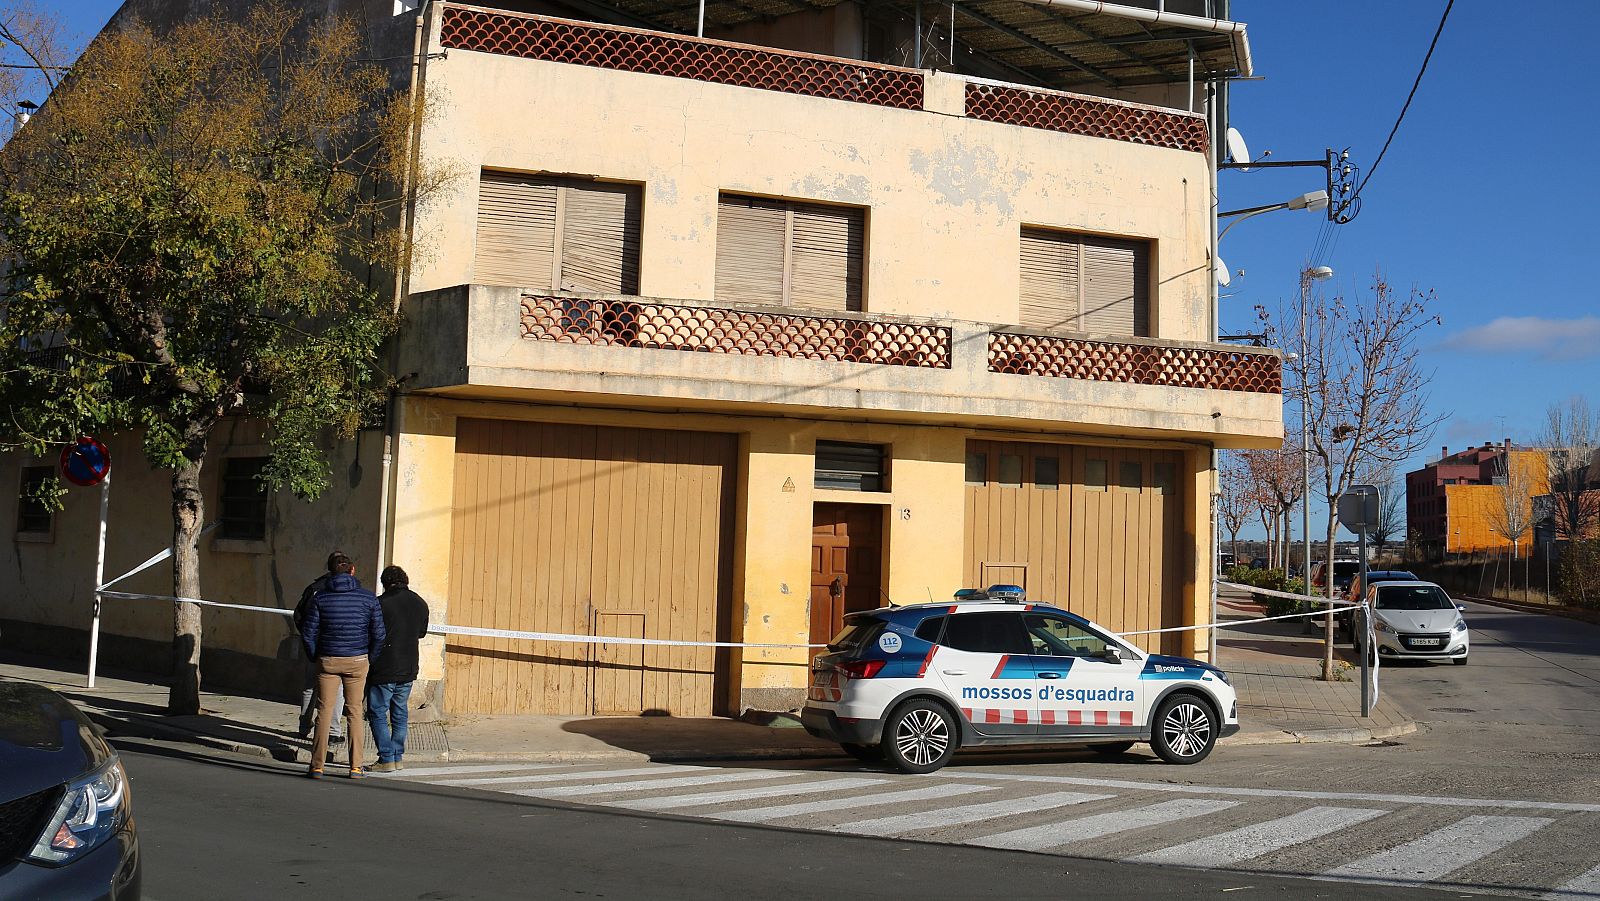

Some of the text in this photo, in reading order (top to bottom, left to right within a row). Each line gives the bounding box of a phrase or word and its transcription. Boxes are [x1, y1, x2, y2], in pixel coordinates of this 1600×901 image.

[899, 508, 911, 520] 13
[883, 637, 898, 645] 112
[962, 685, 1134, 703] mossos d'esquadra
